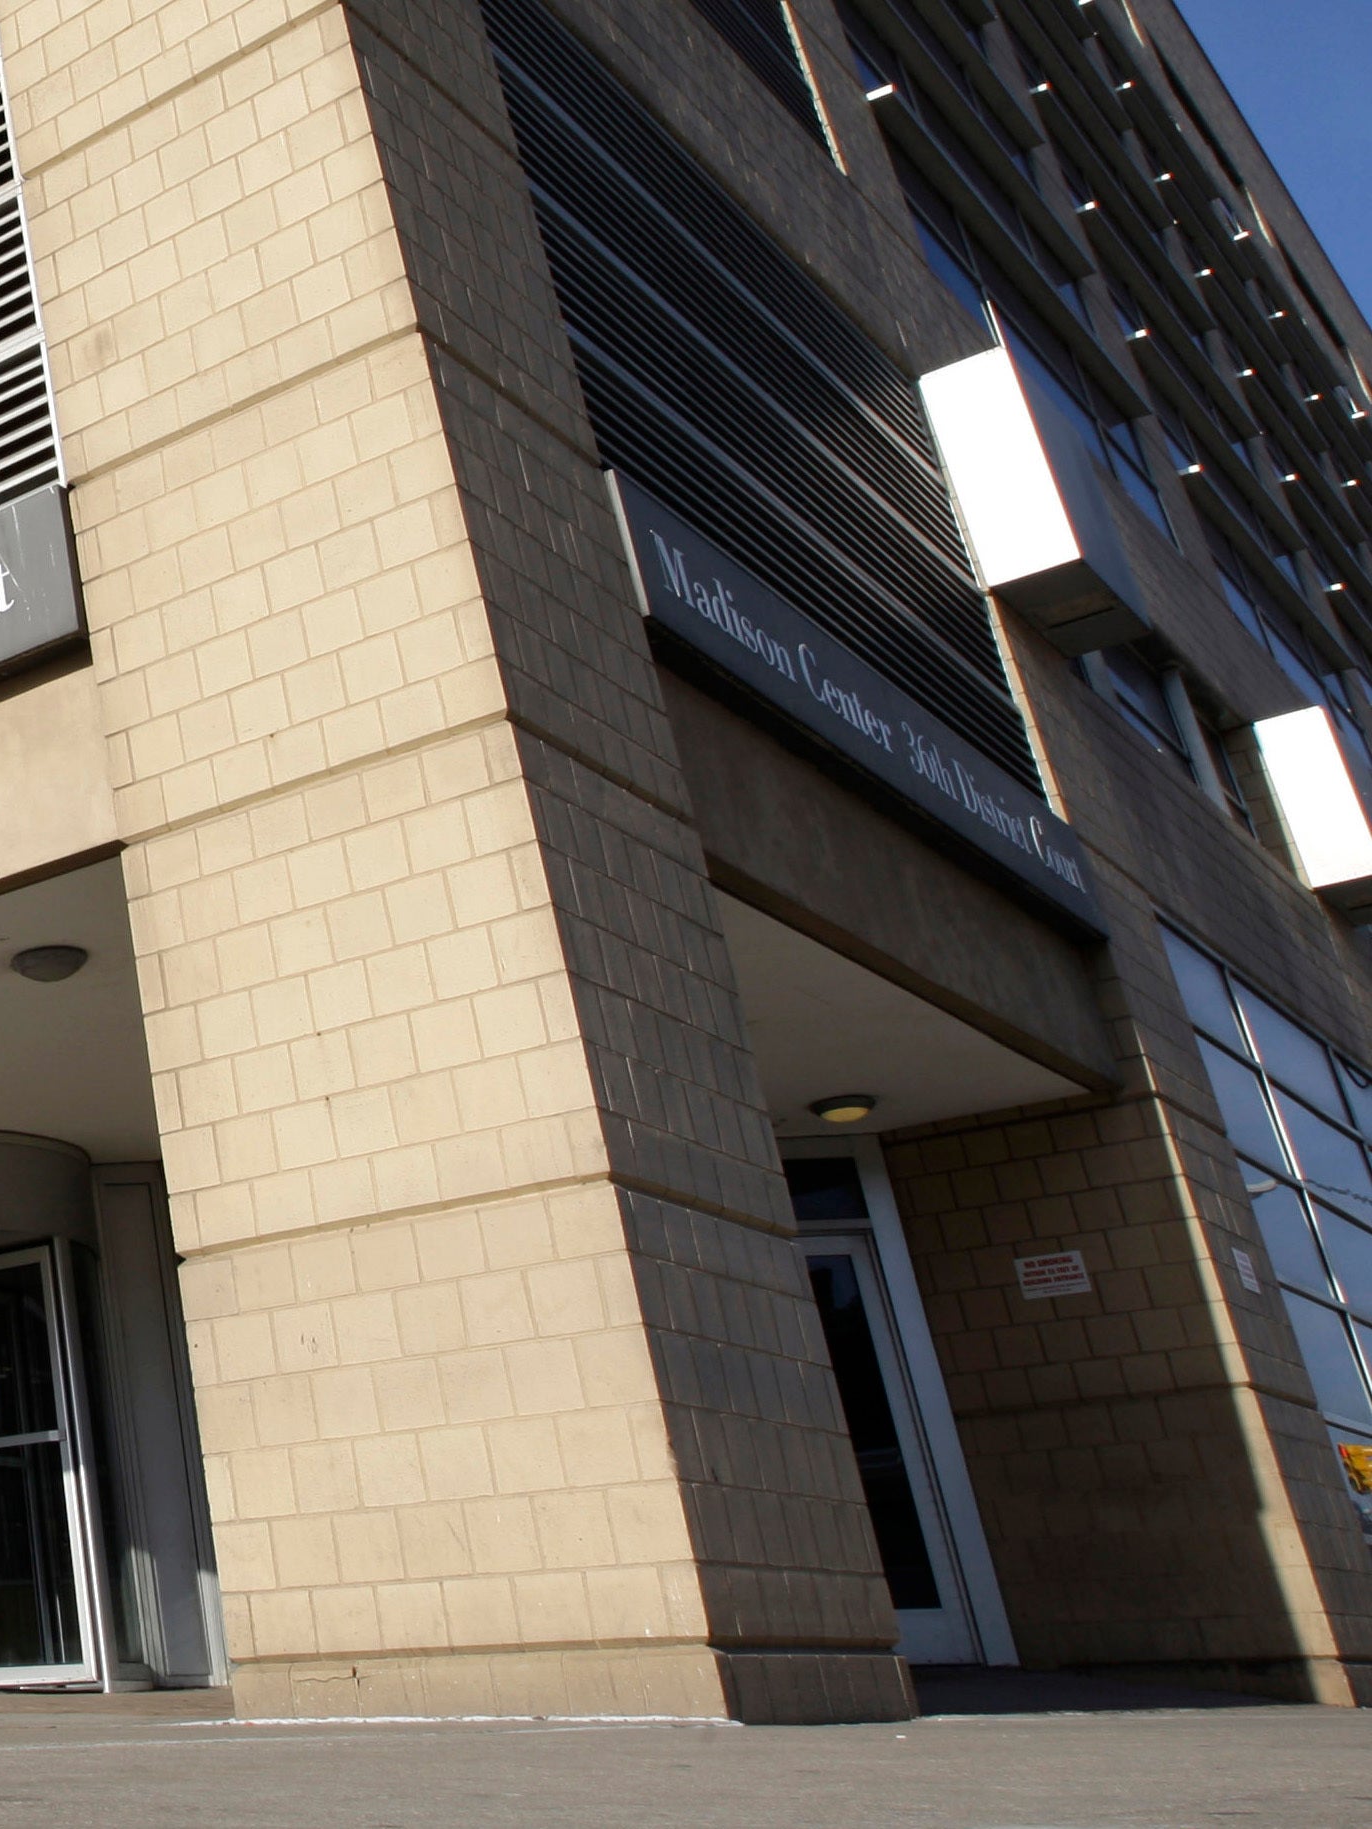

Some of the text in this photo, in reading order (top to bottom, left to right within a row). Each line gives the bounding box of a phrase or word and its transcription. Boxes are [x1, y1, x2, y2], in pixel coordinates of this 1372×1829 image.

[649, 529, 1087, 894] Madison Center 36th District Court
